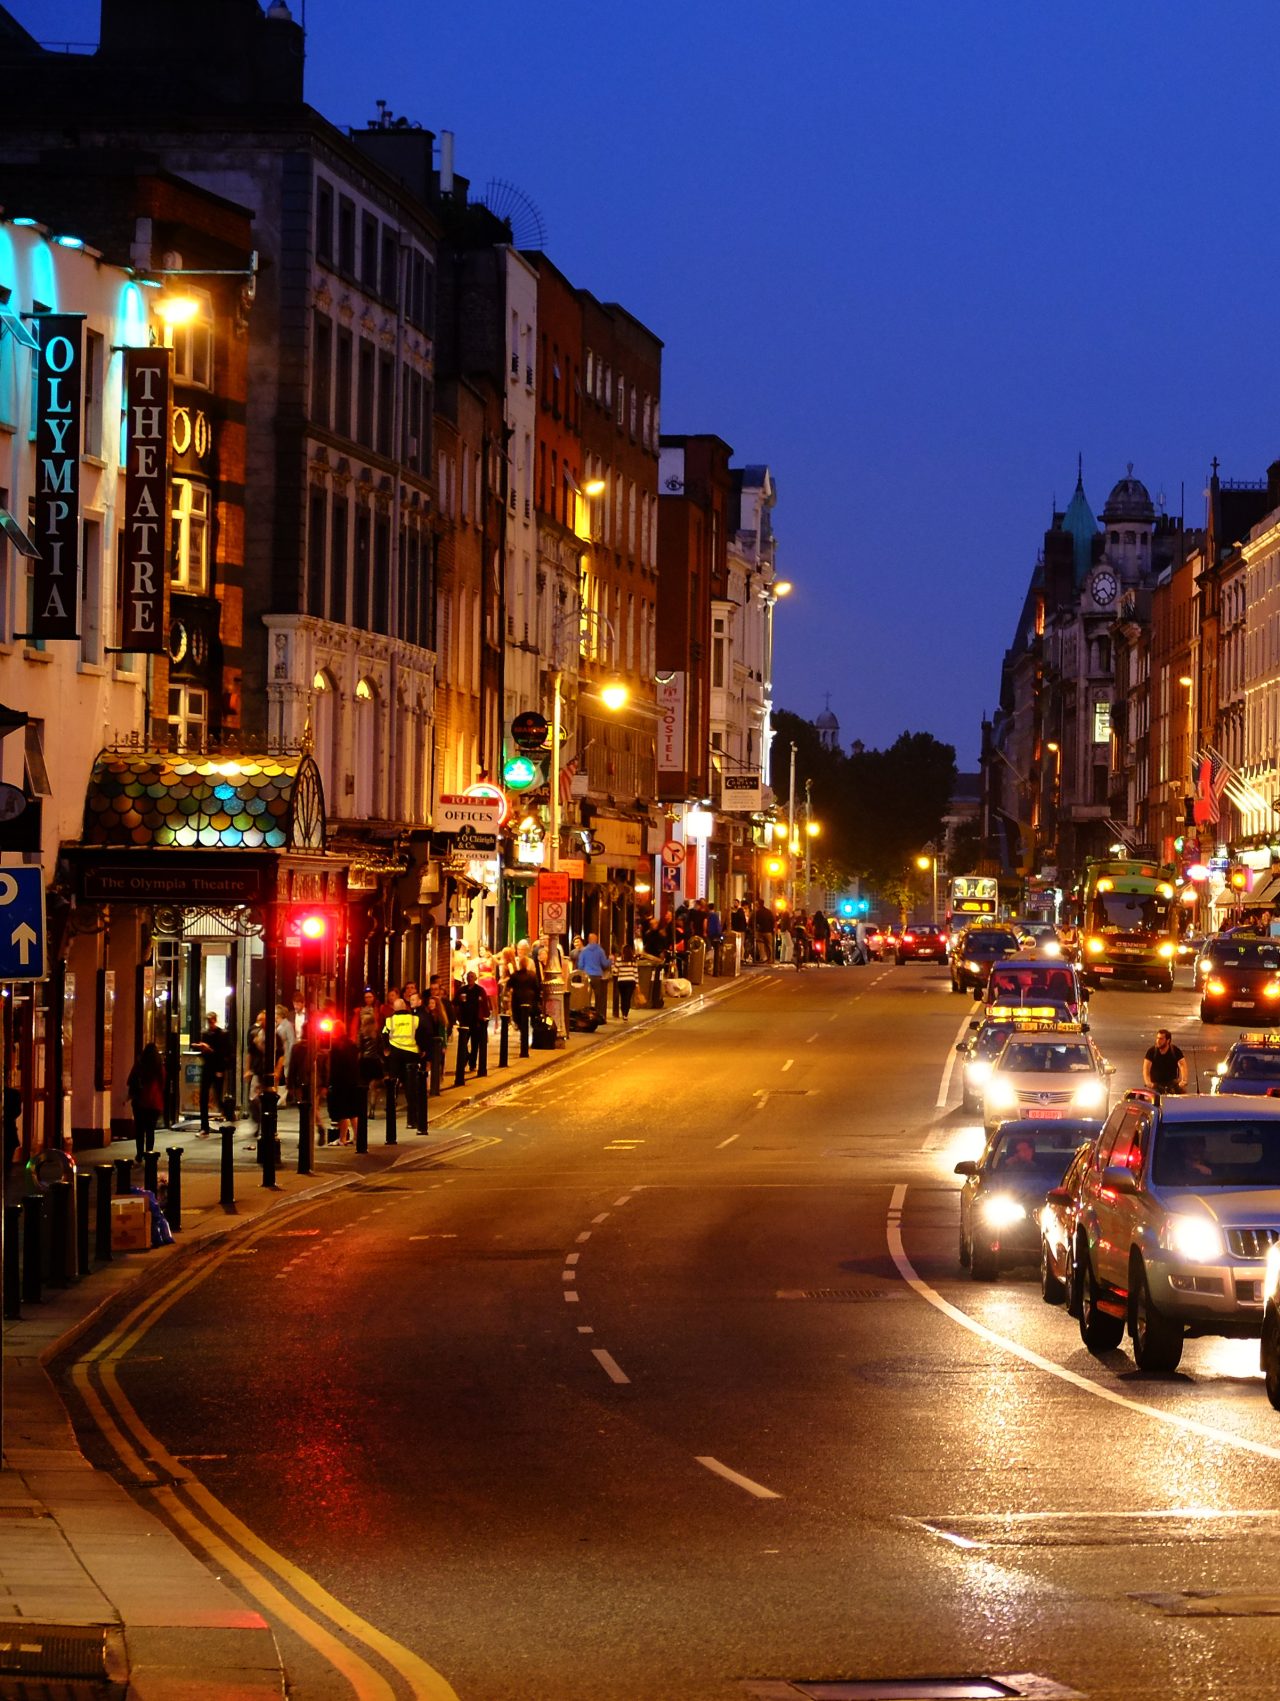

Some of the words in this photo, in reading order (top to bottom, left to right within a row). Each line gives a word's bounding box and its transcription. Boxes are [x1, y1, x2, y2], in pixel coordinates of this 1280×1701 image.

[41, 335, 74, 618] OLYMPIA
[130, 367, 162, 632] THEATRE
[100, 877, 125, 888] The
[130, 877, 186, 891] Olympia
[192, 878, 245, 890] Theatre
[444, 810, 493, 822] OFFICES
